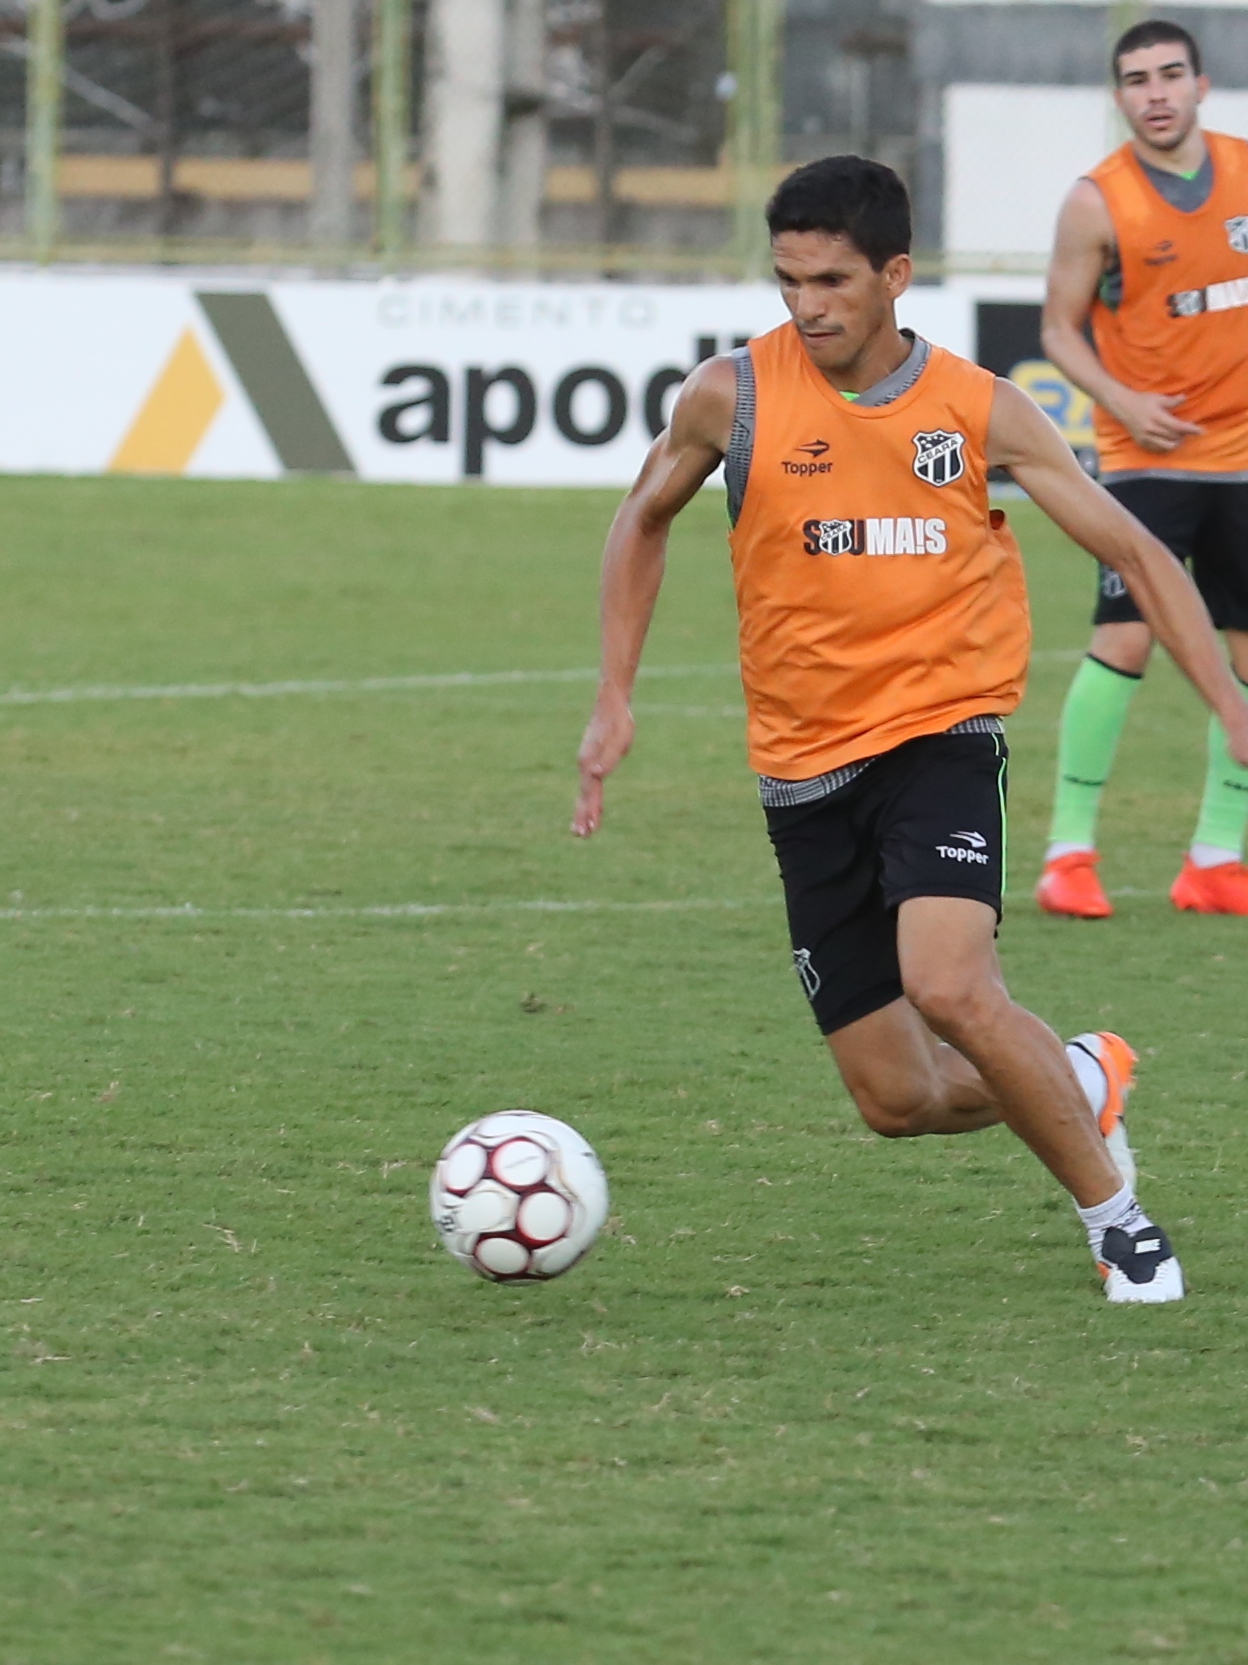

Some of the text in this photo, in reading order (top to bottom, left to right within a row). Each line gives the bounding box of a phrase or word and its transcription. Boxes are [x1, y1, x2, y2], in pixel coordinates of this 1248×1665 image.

[377, 295, 656, 327] CIMENTO
[379, 336, 752, 476] apod
[781, 461, 833, 476] Topper
[935, 845, 990, 865] Topper
